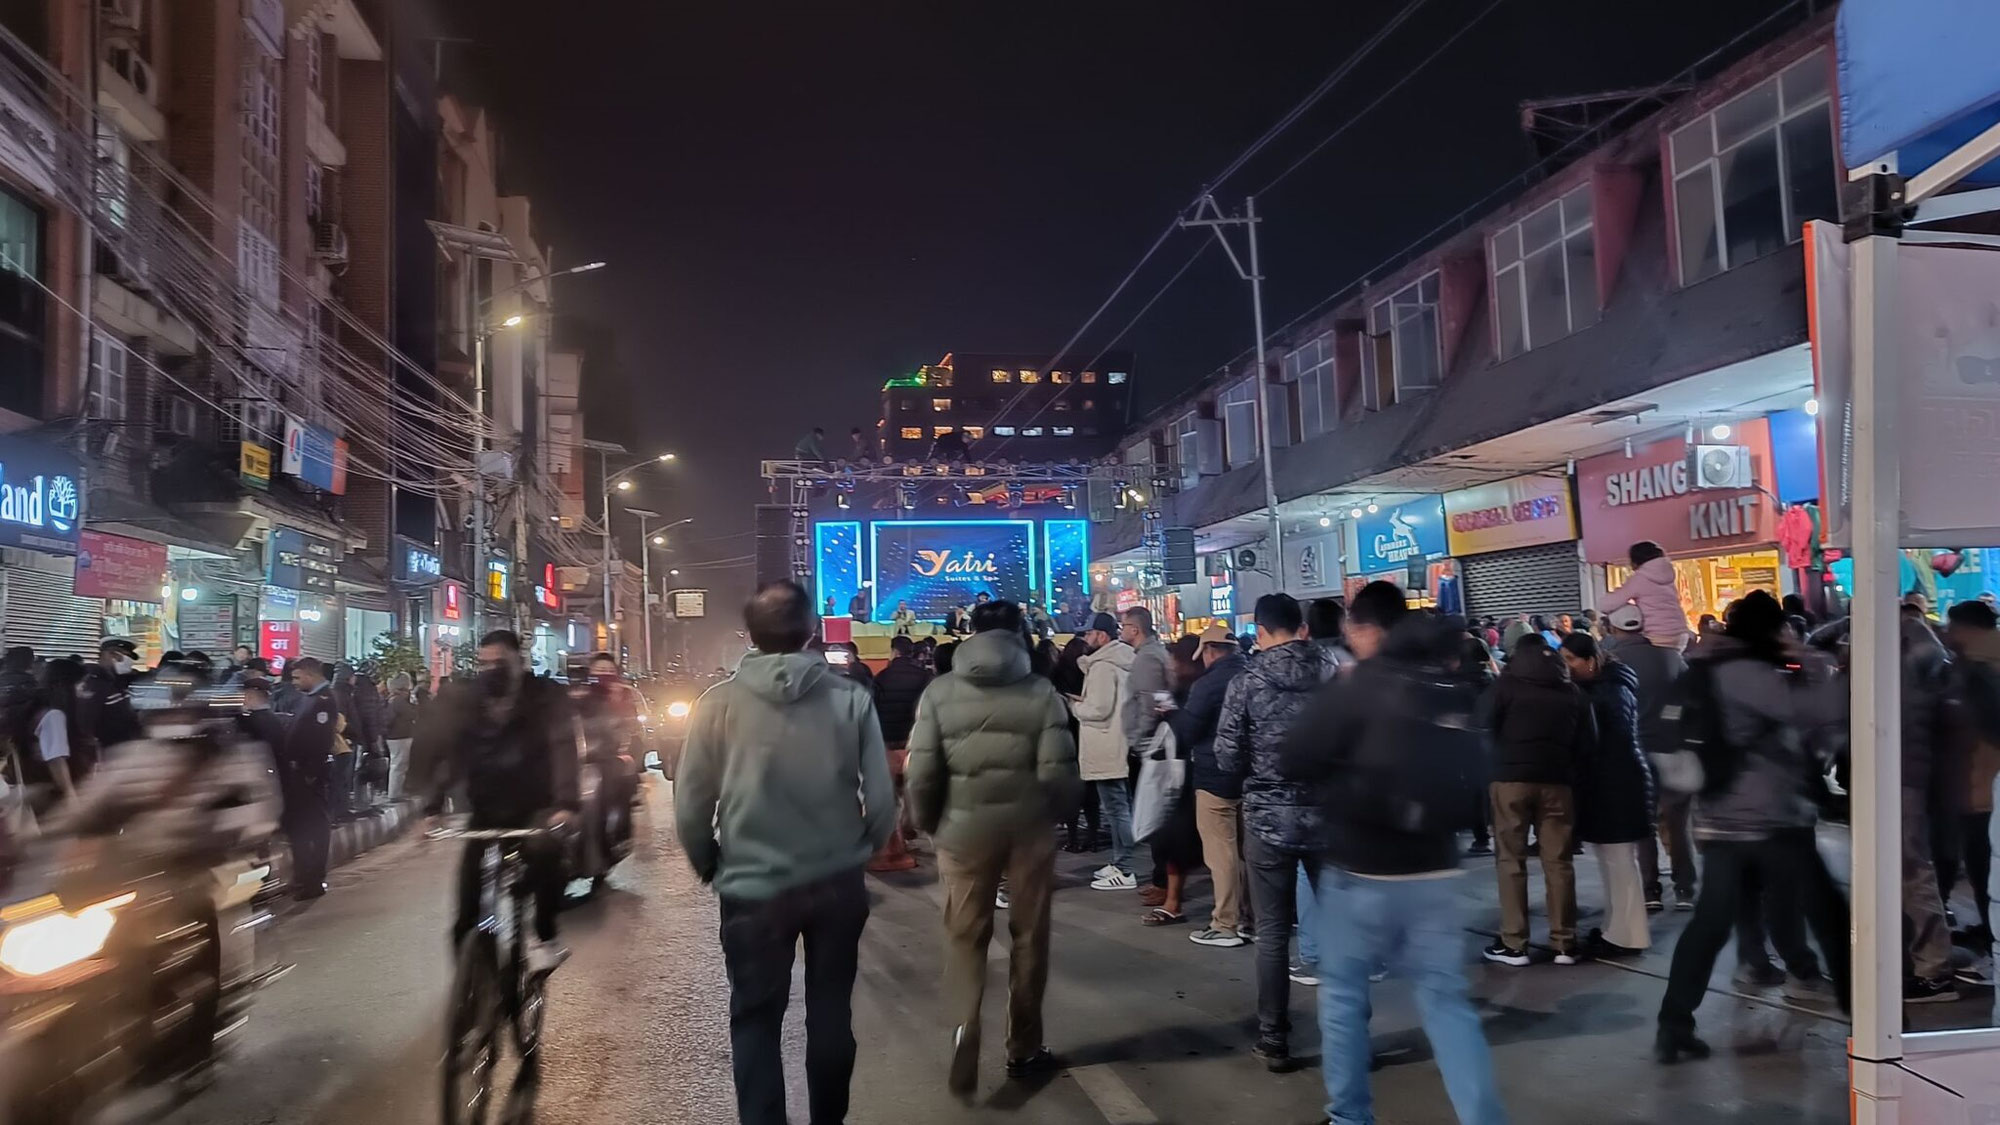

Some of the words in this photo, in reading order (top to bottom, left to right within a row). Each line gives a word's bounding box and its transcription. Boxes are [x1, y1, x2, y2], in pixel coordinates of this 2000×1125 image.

[0, 475, 44, 526] and
[1606, 460, 1700, 506] SHANG
[1689, 496, 1759, 540] KNIT
[911, 550, 997, 576] Yatri
